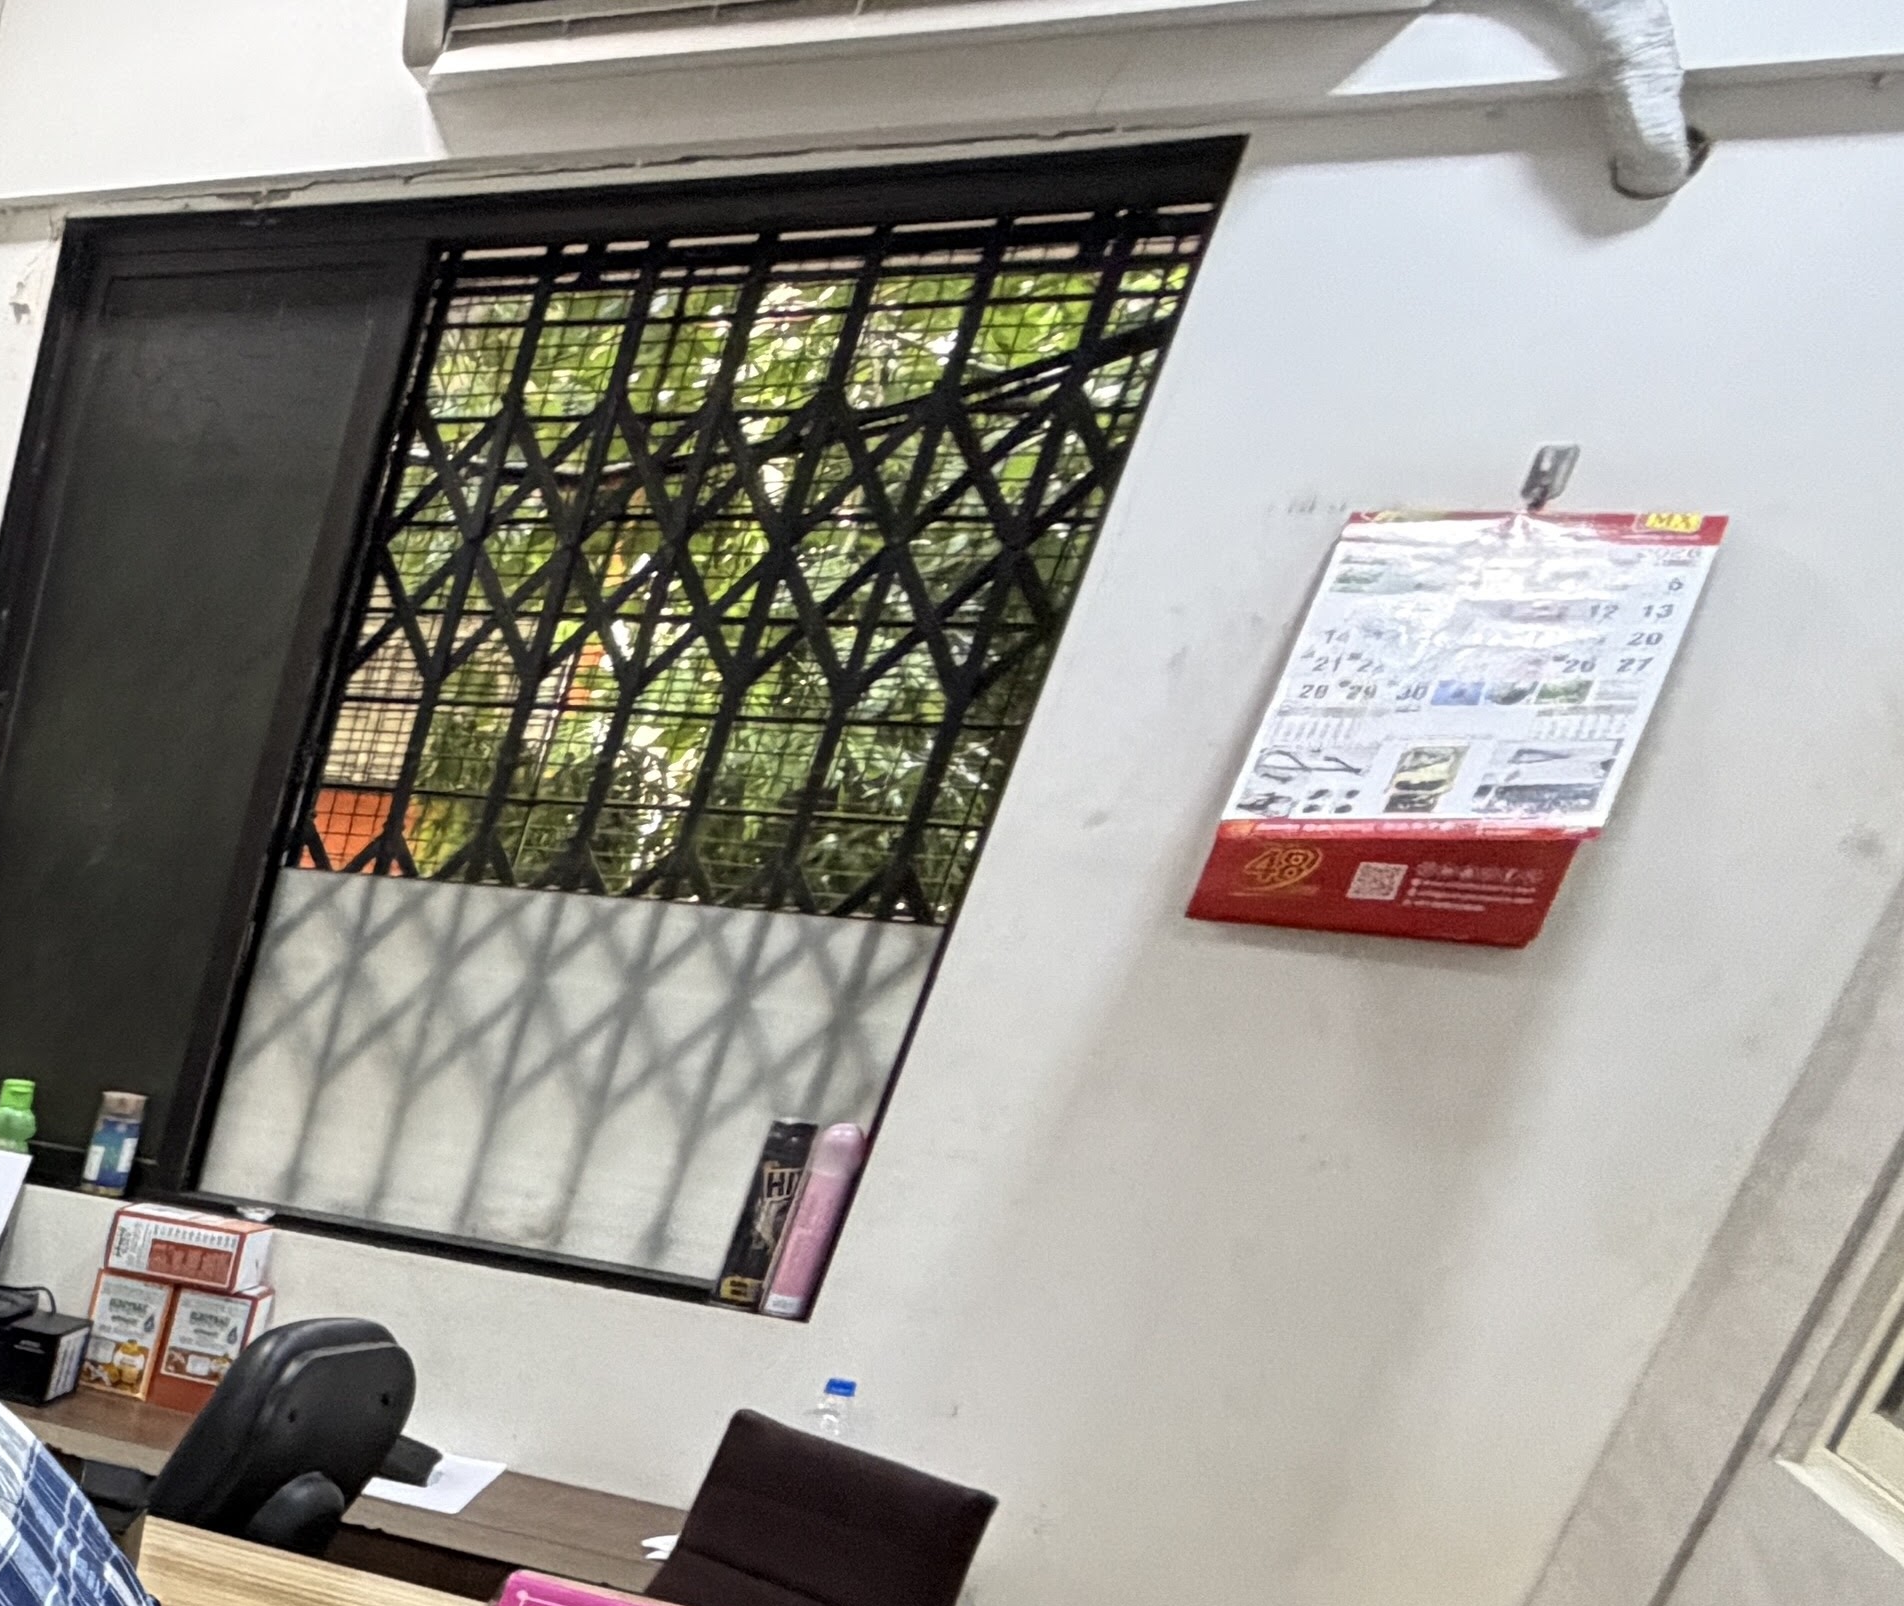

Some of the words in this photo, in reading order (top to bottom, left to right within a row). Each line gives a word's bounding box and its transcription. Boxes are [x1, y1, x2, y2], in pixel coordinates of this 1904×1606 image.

[1643, 604, 1674, 620] 13
[1627, 632, 1663, 646] 20
[1617, 656, 1654, 673] 27
